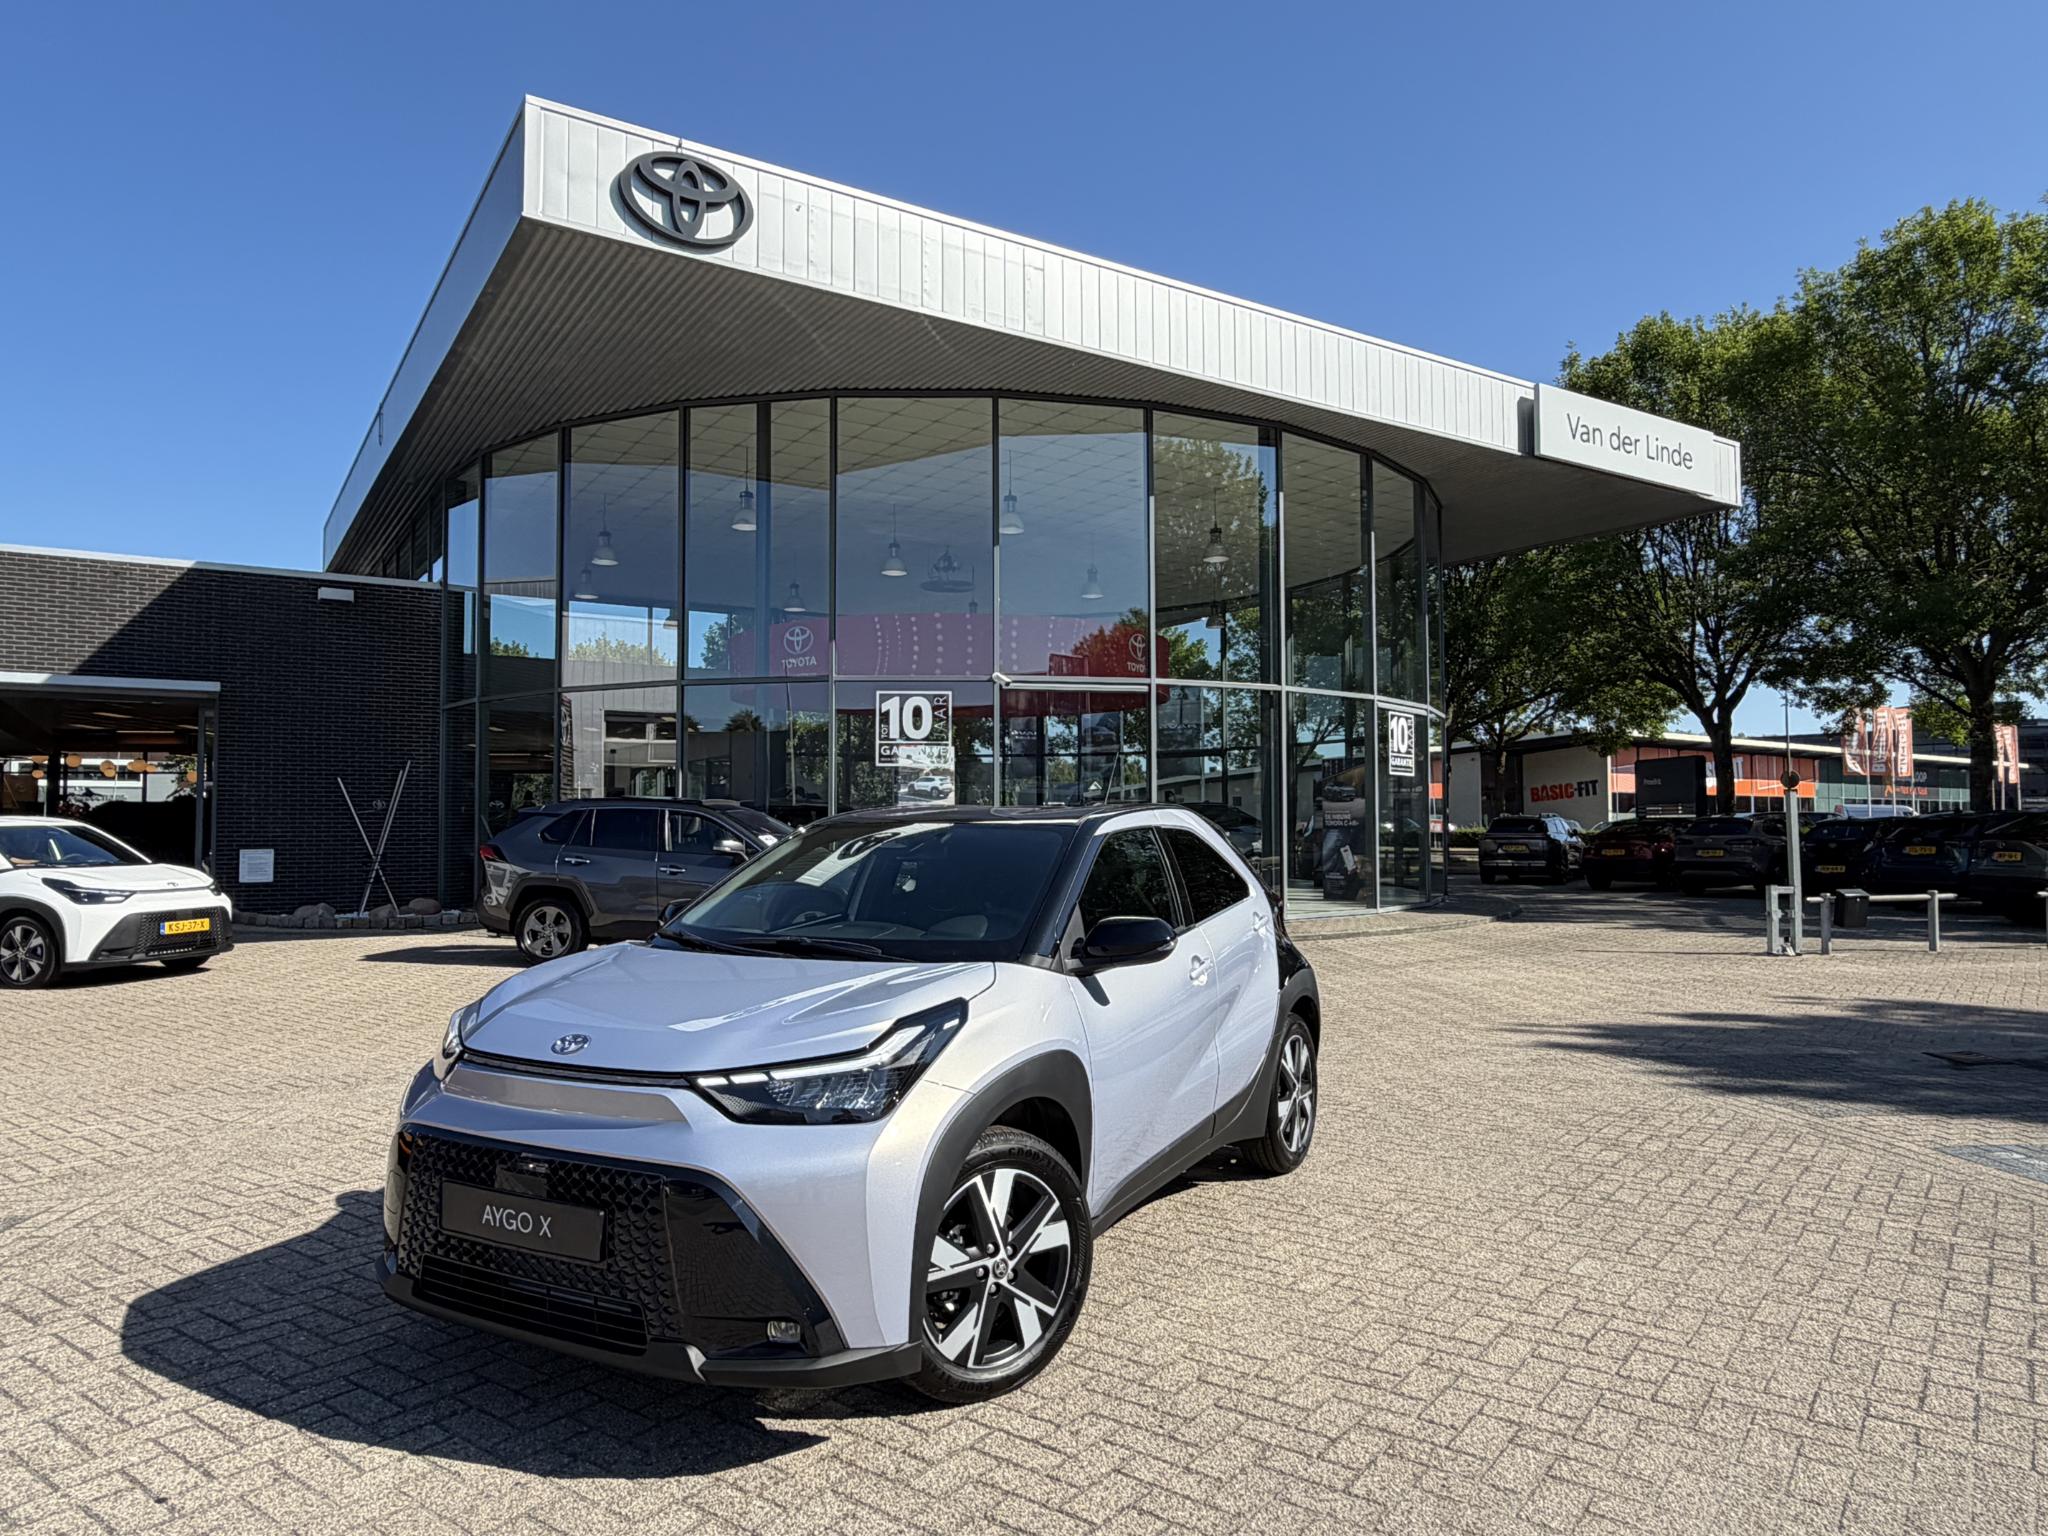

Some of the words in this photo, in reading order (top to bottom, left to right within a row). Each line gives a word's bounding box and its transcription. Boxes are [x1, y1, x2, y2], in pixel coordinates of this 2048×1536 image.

[1566, 412, 1603, 447] Van
[1609, 425, 1640, 456] der
[1646, 434, 1693, 470] Linde
[781, 656, 817, 669] TOYOTA
[1127, 661, 1146, 673] TOYO
[881, 696, 933, 740] 10
[934, 696, 947, 740] JAAR
[1390, 716, 1408, 753] 10
[880, 745, 949, 757] GANTIE
[1530, 780, 1599, 802] BASIC-FIT
[168, 921, 206, 932] KSJ-37-X
[482, 1204, 533, 1233] AYGO
[539, 1215, 552, 1238] X
